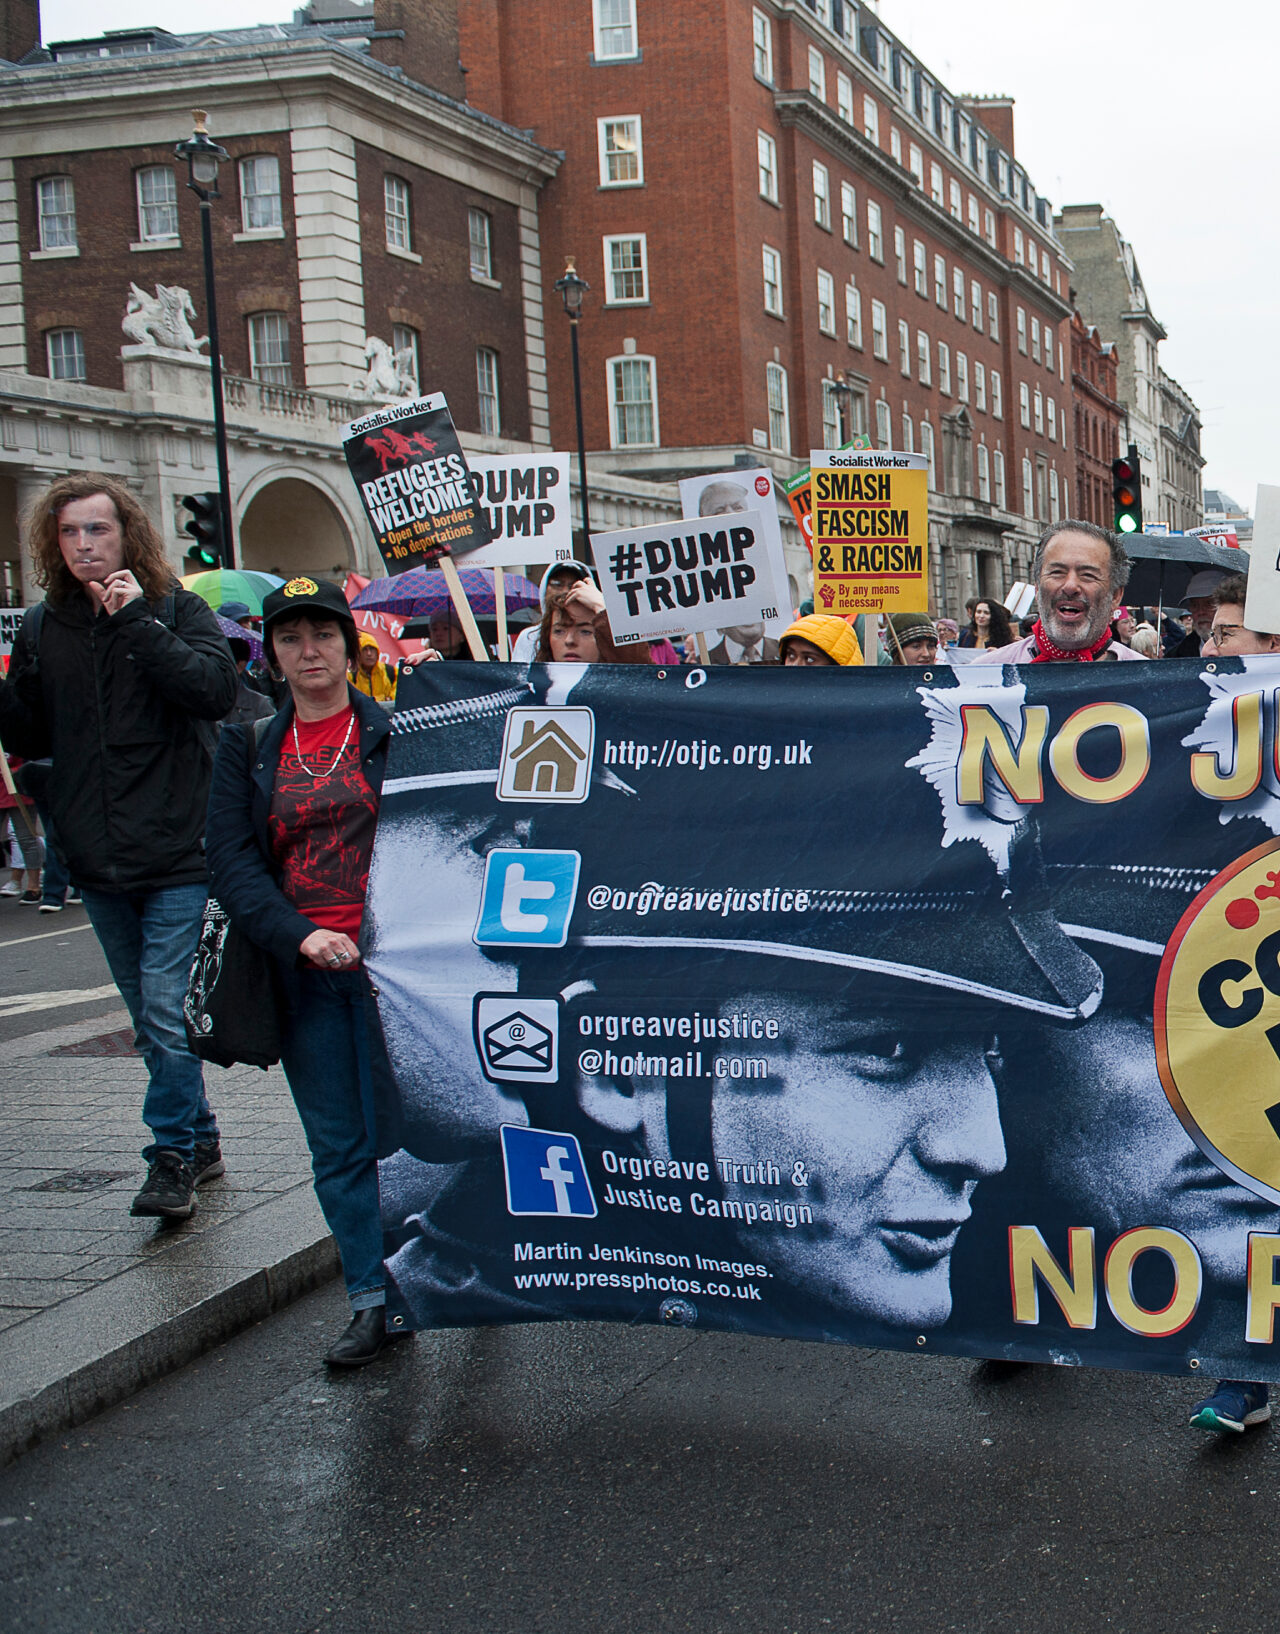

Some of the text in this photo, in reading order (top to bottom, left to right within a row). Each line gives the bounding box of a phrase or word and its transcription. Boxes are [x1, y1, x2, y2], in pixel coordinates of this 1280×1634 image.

[350, 400, 432, 436] Socialist Worker
[829, 456, 911, 468] Socialist Worker
[361, 453, 466, 509] REFUGEES
[816, 473, 891, 501] SMASH
[369, 480, 473, 533] WELCOME
[817, 510, 909, 537] FASCISM
[388, 508, 475, 546] Open the borders
[393, 543, 408, 559] No
[409, 524, 473, 553] deportations
[609, 526, 756, 582] #DUMP
[818, 545, 922, 573] & RACISM
[616, 563, 757, 618] TRUMP
[838, 584, 900, 597] By any means
[839, 598, 884, 609] necessary
[761, 607, 779, 620] FOA
[602, 739, 814, 771] http://otjc.org.uk
[956, 701, 1150, 805] NO
[587, 884, 811, 917] @orgreavejustice
[578, 1012, 780, 1043] orgreavejustice
[577, 1048, 769, 1079] @hotmail.com
[601, 1149, 810, 1188] Orgreave Truth &
[603, 1183, 814, 1229] Justice Campaign
[513, 1242, 774, 1278] Martin Jenkinson Images.
[513, 1269, 763, 1301] www.pressphotos.co.uk
[1007, 1225, 1203, 1338] NO
